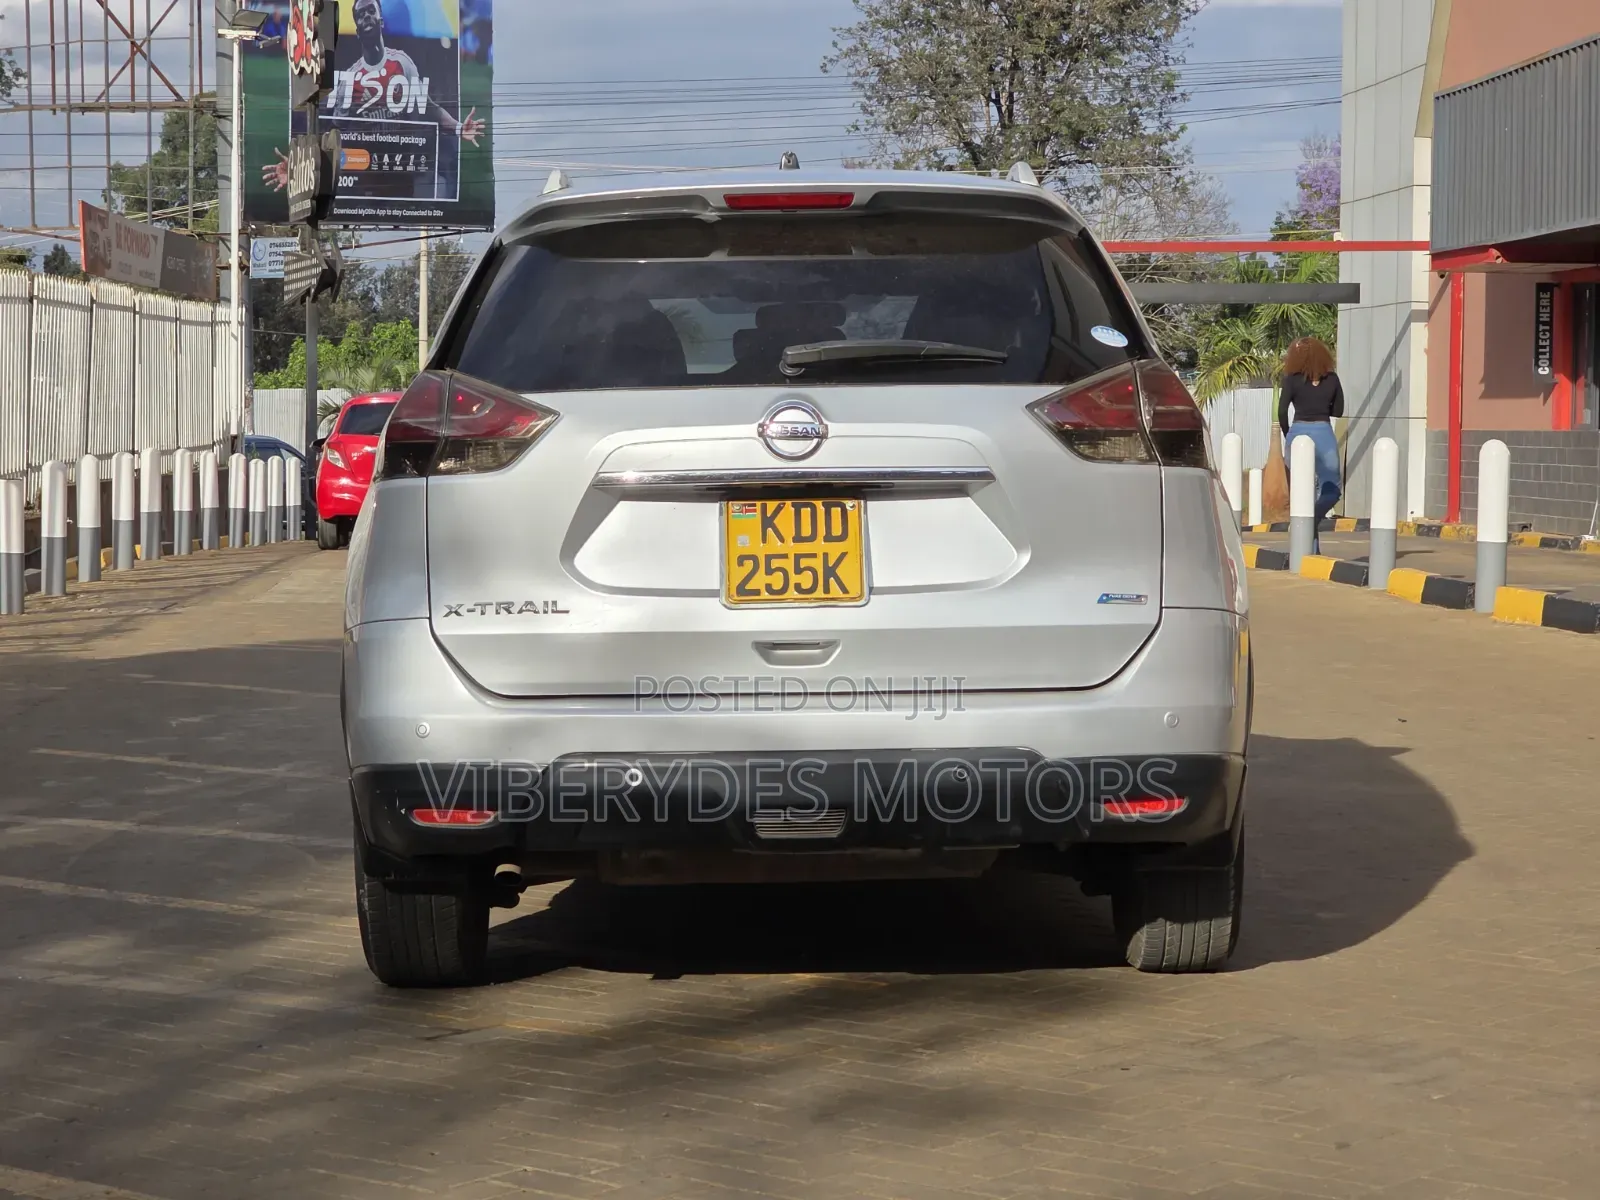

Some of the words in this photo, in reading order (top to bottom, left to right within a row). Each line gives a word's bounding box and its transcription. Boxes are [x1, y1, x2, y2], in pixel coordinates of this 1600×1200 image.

[326, 68, 386, 114] IT'S
[386, 74, 430, 115] ON
[362, 133, 376, 142] best
[376, 133, 399, 143] football
[400, 135, 426, 146] package
[288, 146, 315, 199] Galito's
[333, 207, 358, 215] Download
[392, 209, 402, 217] stay
[1539, 291, 1551, 322] HERE
[1538, 323, 1550, 375] COLLECT
[760, 502, 849, 544] KDD
[736, 551, 850, 597] 255K
[443, 600, 571, 618] X-TRAIL
